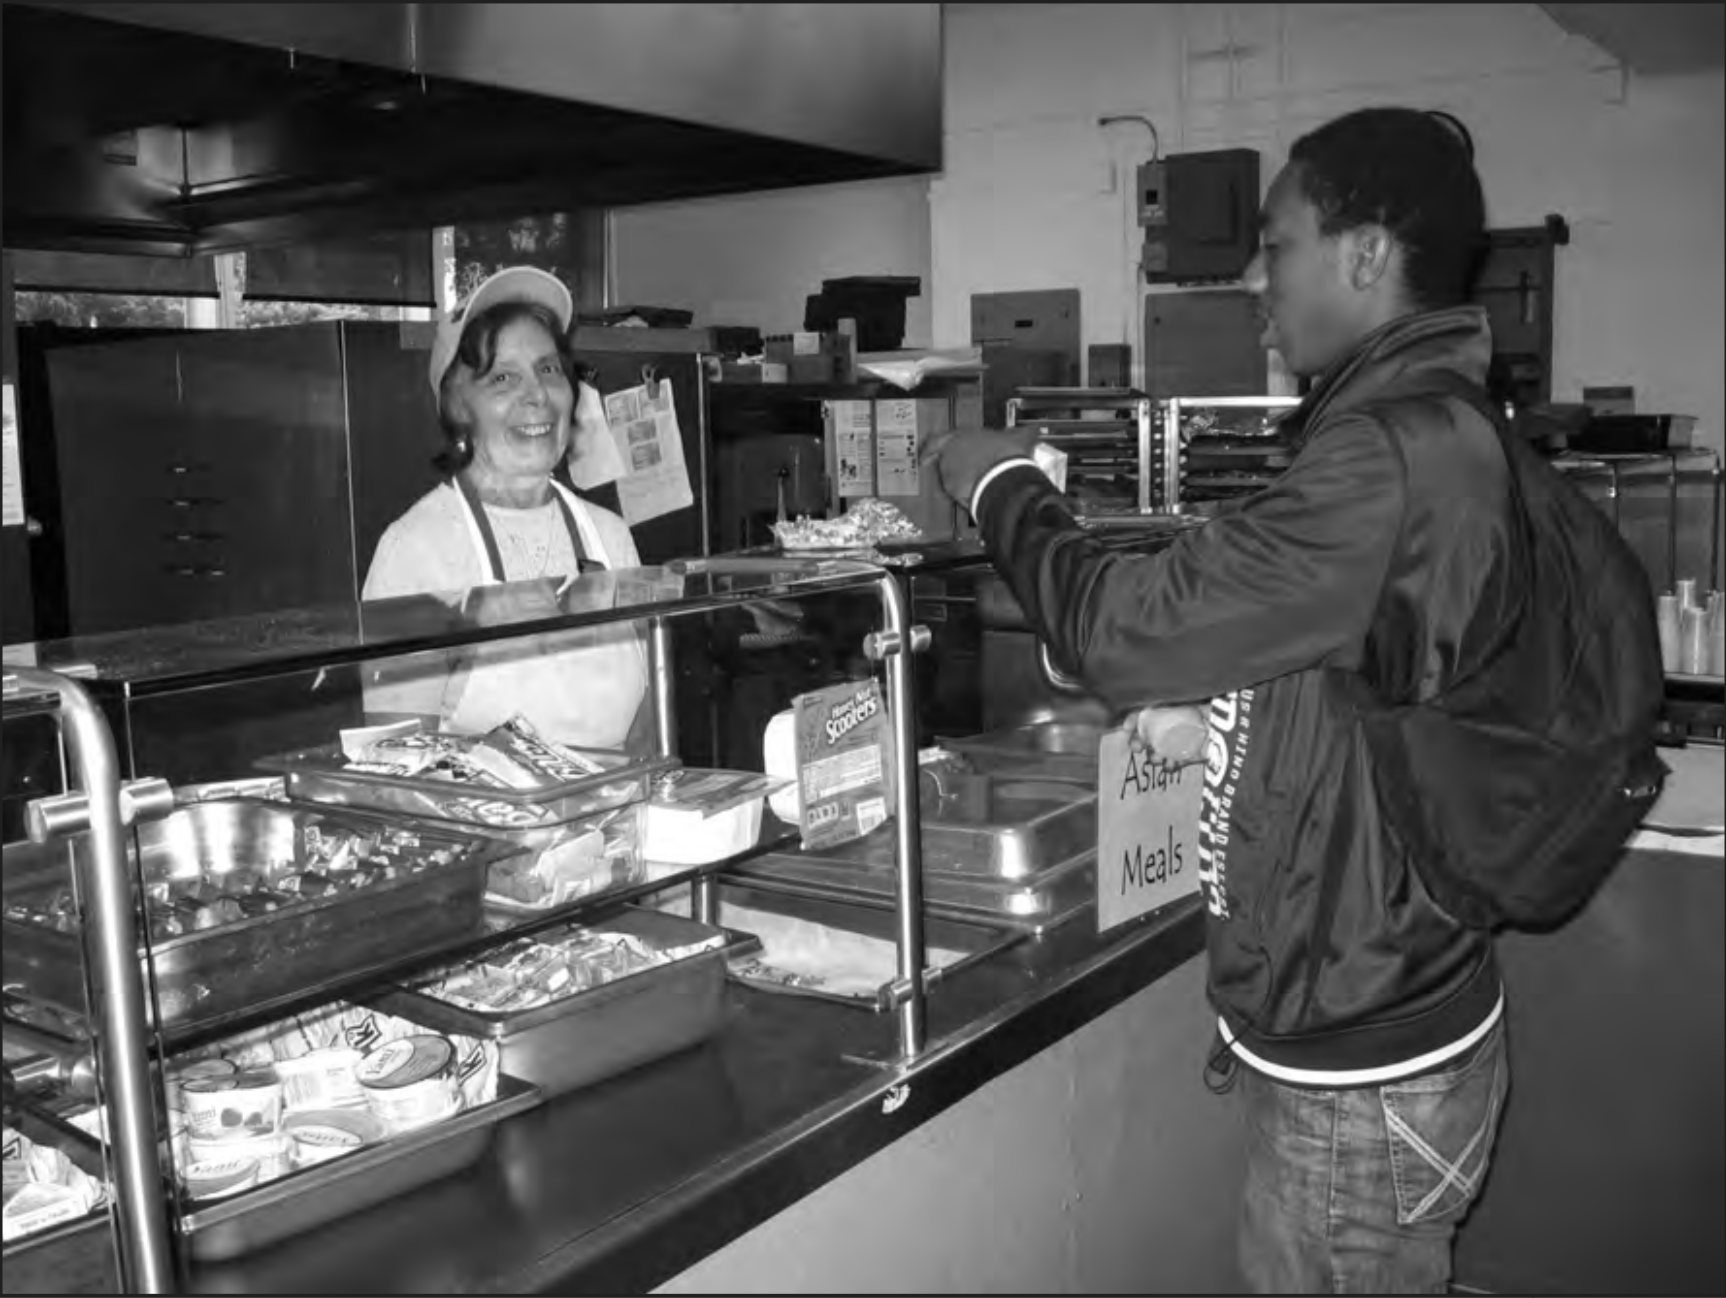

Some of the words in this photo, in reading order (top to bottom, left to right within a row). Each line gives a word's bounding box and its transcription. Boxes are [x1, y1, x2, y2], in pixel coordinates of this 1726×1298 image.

[826, 697, 877, 744] Scooters
[1216, 783, 1236, 846] BRAND
[1121, 824, 1183, 895] Meals
